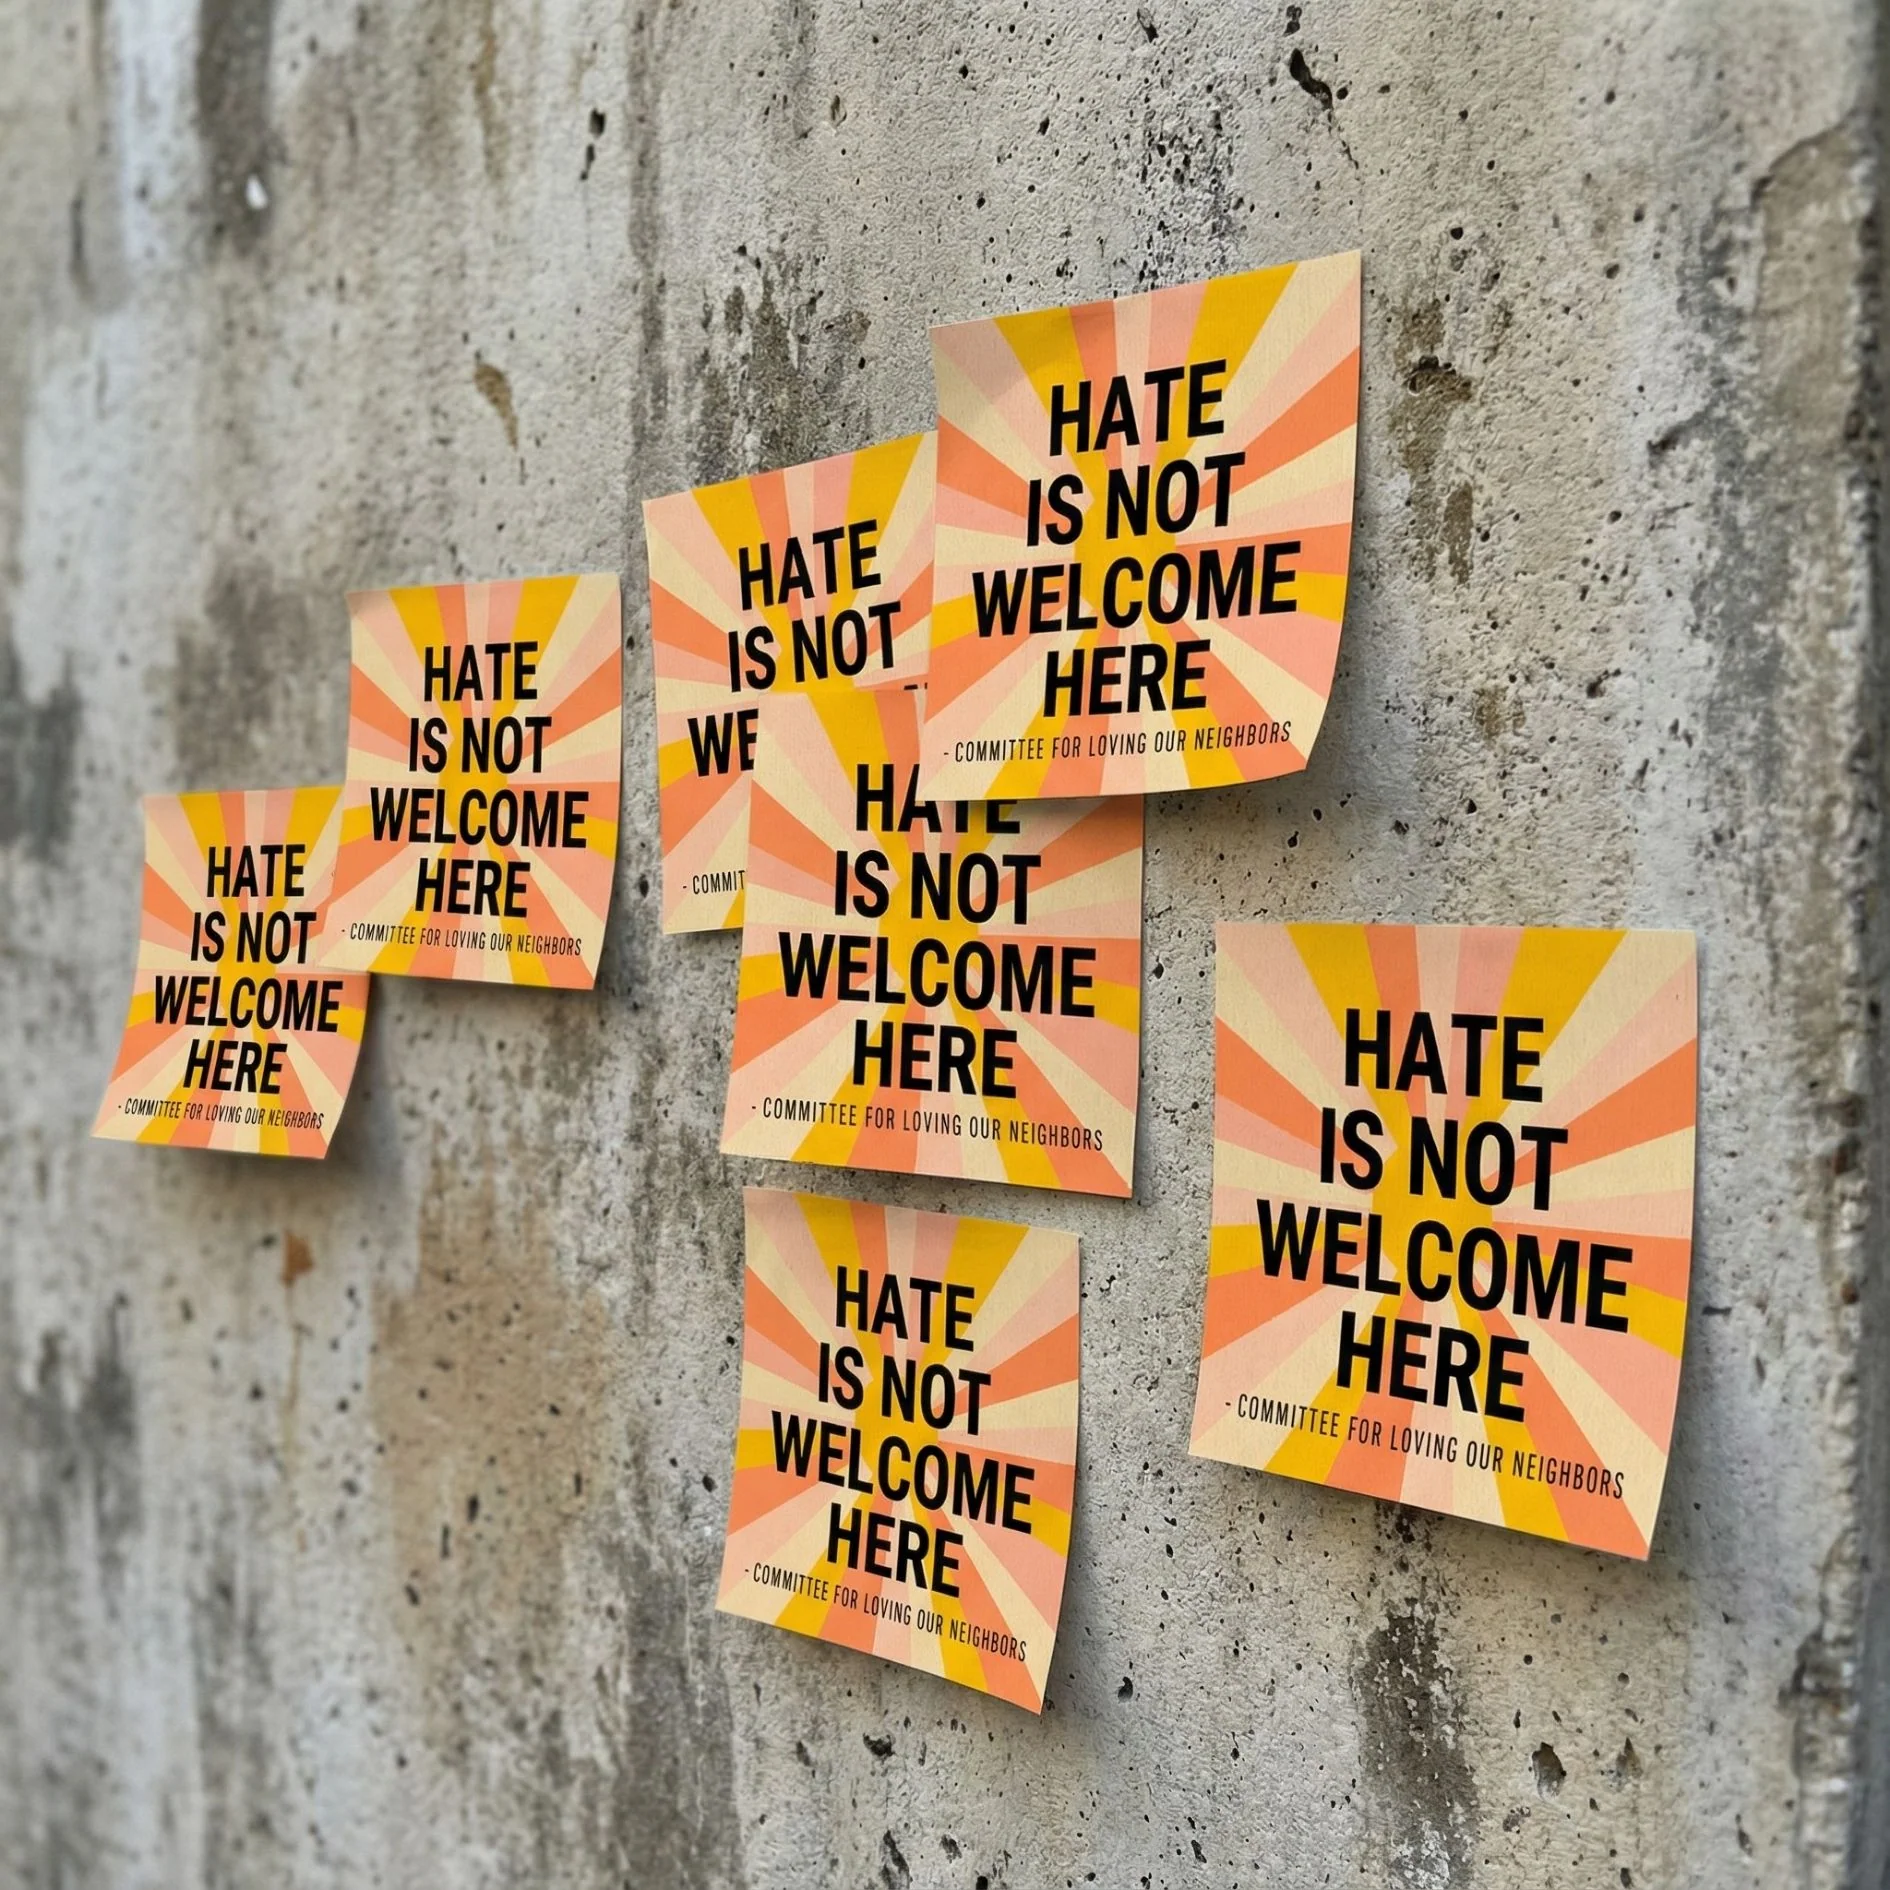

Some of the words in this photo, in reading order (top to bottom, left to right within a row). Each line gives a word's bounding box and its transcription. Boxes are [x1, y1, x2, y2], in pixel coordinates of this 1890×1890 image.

[1050, 360, 1226, 456] HATE
[1027, 474, 1083, 546] IS
[1107, 452, 1245, 539] NOT
[739, 520, 881, 610] HATE
[973, 541, 1300, 637] WELCOME
[425, 642, 537, 701] HATE
[729, 626, 776, 692] IS
[792, 601, 900, 682] NOT
[1044, 640, 1210, 717] HERE
[410, 718, 447, 773] IS
[462, 717, 551, 773] NOT
[956, 738, 1044, 762] COMMITTEE
[1052, 736, 1081, 759] FOR
[1089, 733, 1146, 757] LOVING
[1155, 730, 1186, 752] OUR
[1195, 721, 1291, 750] NEIGHBORS
[371, 788, 588, 848] WELCOME
[207, 845, 305, 897] HATE
[416, 858, 530, 917] HERE
[693, 870, 745, 894] COMMIT
[835, 850, 889, 918] IS
[911, 852, 1041, 924] NOT
[191, 911, 225, 962] IS
[237, 911, 316, 964] NOT
[351, 923, 416, 944] COMMITTEE
[420, 928, 441, 946] FOR
[445, 930, 486, 949] LOVING
[491, 933, 512, 951] OUR
[517, 935, 581, 956] NEIGHBORS
[779, 932, 1095, 1017] WELCOME
[156, 976, 343, 1032] WELCOME
[184, 1039, 287, 1094] HERE
[853, 1020, 1017, 1098] HERE
[1346, 1009, 1543, 1102] HATE
[125, 1098, 182, 1119] COMMITTEE
[184, 1103, 203, 1120] FOR
[206, 1104, 242, 1123] LOVING
[245, 1108, 265, 1125] OUR
[268, 1109, 324, 1129] NEIGHBORS
[764, 1097, 856, 1126] COMMITTEE
[866, 1106, 894, 1130] FOR
[903, 1110, 961, 1135] LOVING
[970, 1116, 1001, 1140] OUR
[1010, 1120, 1102, 1151] NEIGHBORS
[1321, 1107, 1383, 1190] IS
[1410, 1117, 1568, 1210] NOT
[1257, 1199, 1632, 1332] WELCOME
[836, 1266, 974, 1351] HATE
[819, 1343, 863, 1409] IS
[882, 1356, 991, 1435] NOT
[1337, 1311, 1529, 1422] HERE
[772, 1411, 1034, 1534] WELCOME
[1238, 1394, 1340, 1437] COMMITTEE
[1348, 1416, 1382, 1447] FOR
[1390, 1425, 1457, 1462] LOVING
[1466, 1441, 1503, 1473] OUR
[1512, 1450, 1624, 1499] NEIGHBORS
[828, 1503, 963, 1597] HERE
[754, 1563, 829, 1601] COMMITTEE
[834, 1585, 858, 1609] FOR
[864, 1593, 911, 1625] LOVING
[917, 1609, 943, 1635] OUR
[950, 1619, 1026, 1662] NEIGHBORS
